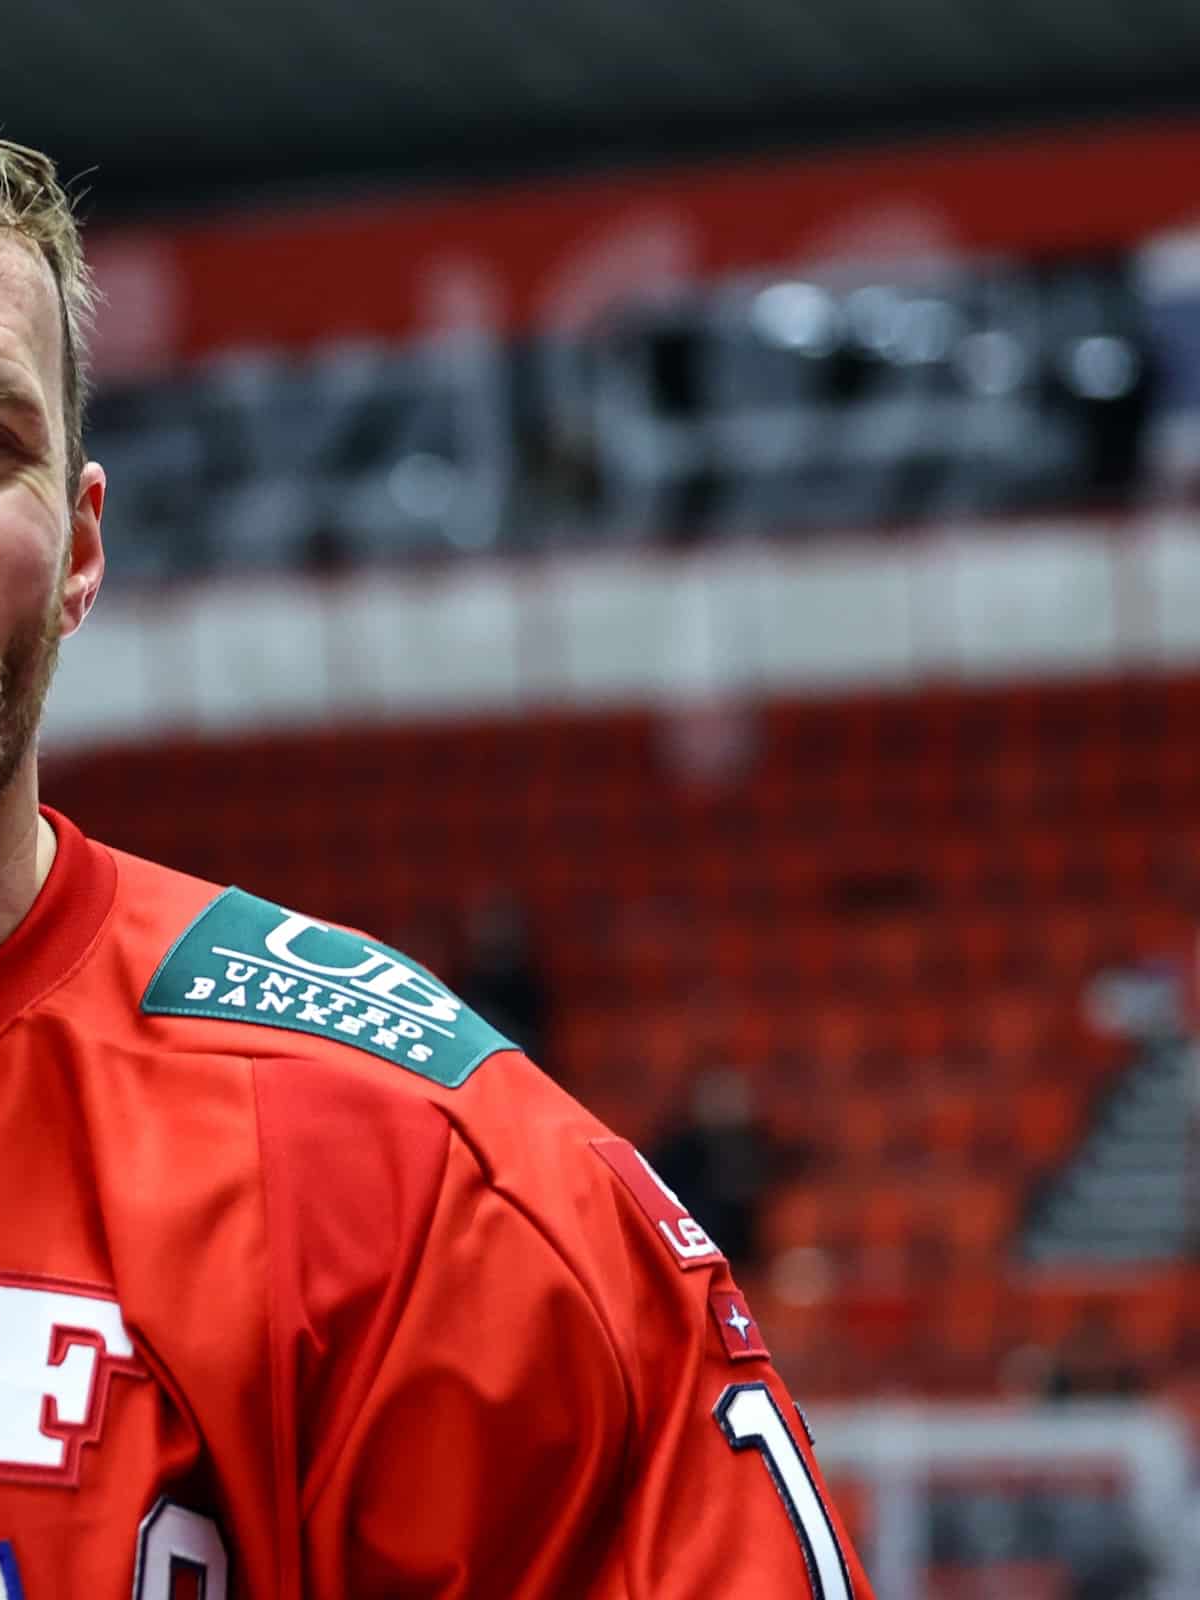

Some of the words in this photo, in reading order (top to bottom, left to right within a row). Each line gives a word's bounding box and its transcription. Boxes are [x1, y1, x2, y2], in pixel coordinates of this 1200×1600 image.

[184, 976, 434, 1063] BANKERS
[224, 961, 424, 1040] UNITED
[711, 1380, 855, 1600] 1
